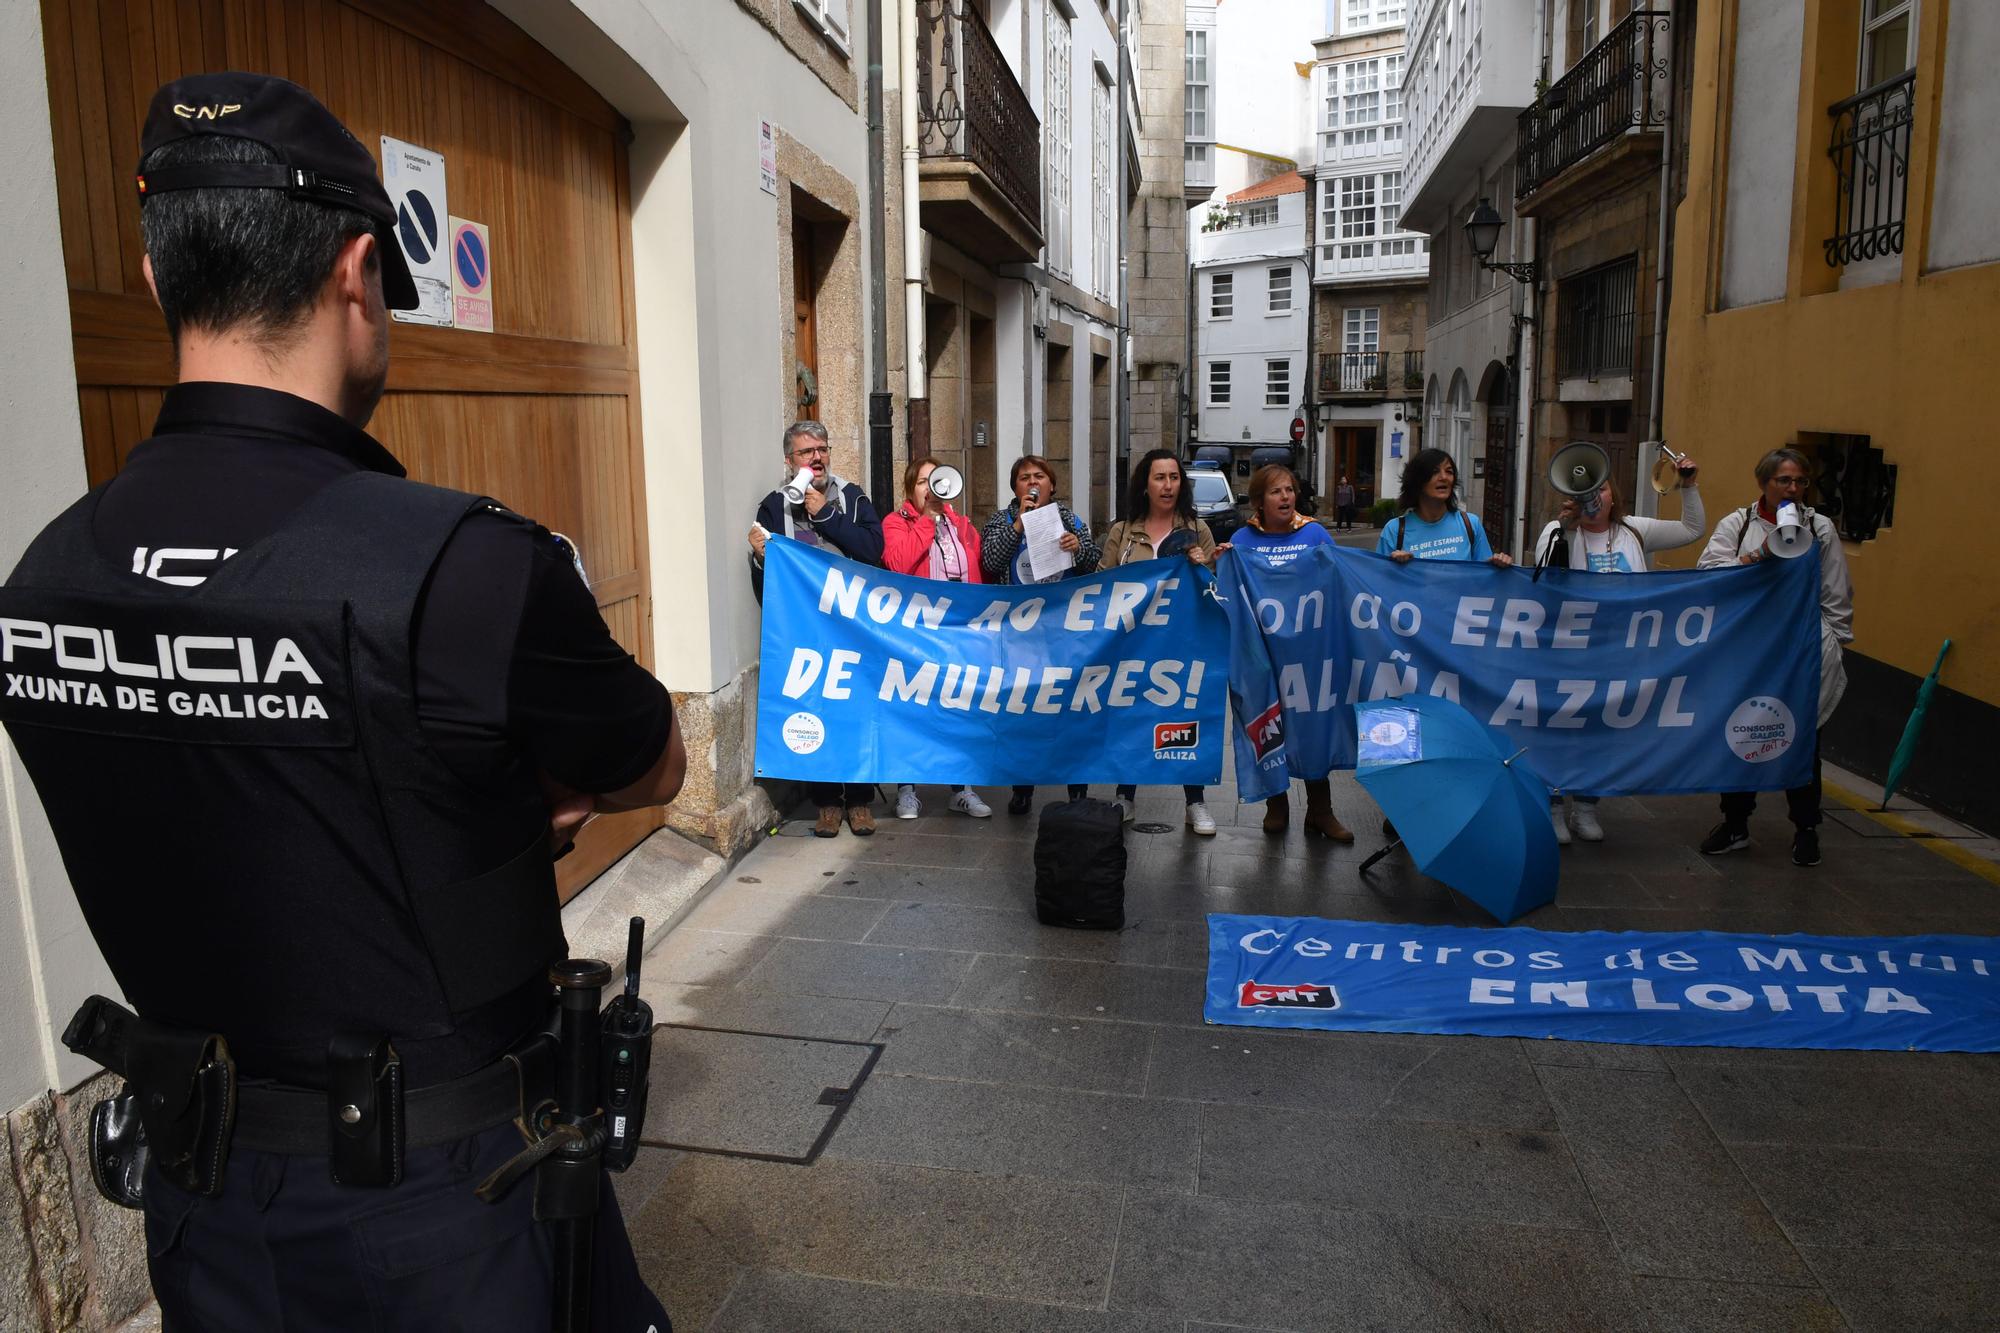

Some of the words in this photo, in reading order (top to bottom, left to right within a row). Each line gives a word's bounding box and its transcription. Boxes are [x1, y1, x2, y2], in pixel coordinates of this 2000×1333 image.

[173, 104, 242, 119] CNP
[1433, 536, 1464, 547] ESTAMOS
[818, 567, 952, 631] NON
[1064, 578, 1180, 633] ERE
[1239, 584, 1324, 635] on
[1350, 592, 1422, 638] ao
[1450, 596, 1600, 649] ERE
[1625, 605, 1716, 648] na
[0, 617, 324, 685] POLICIA
[782, 647, 861, 700] DE
[878, 658, 1205, 715] MULLERES!
[5, 673, 108, 708] XUNTA
[115, 686, 159, 713] DE
[168, 691, 329, 719] GALICIA
[1488, 675, 1695, 729] AZUL
[1160, 729, 1191, 742] CNT
[1733, 723, 1785, 733] CONSORCIO
[1750, 731, 1786, 740] GALEGO
[1154, 751, 1197, 761] GALIZA
[1239, 929, 1564, 970] Centros
[1252, 989, 1320, 1003] CNT
[1469, 977, 1589, 1008] EN
[1632, 977, 1932, 1014] LOITA
[616, 1118, 625, 1136] 2012
